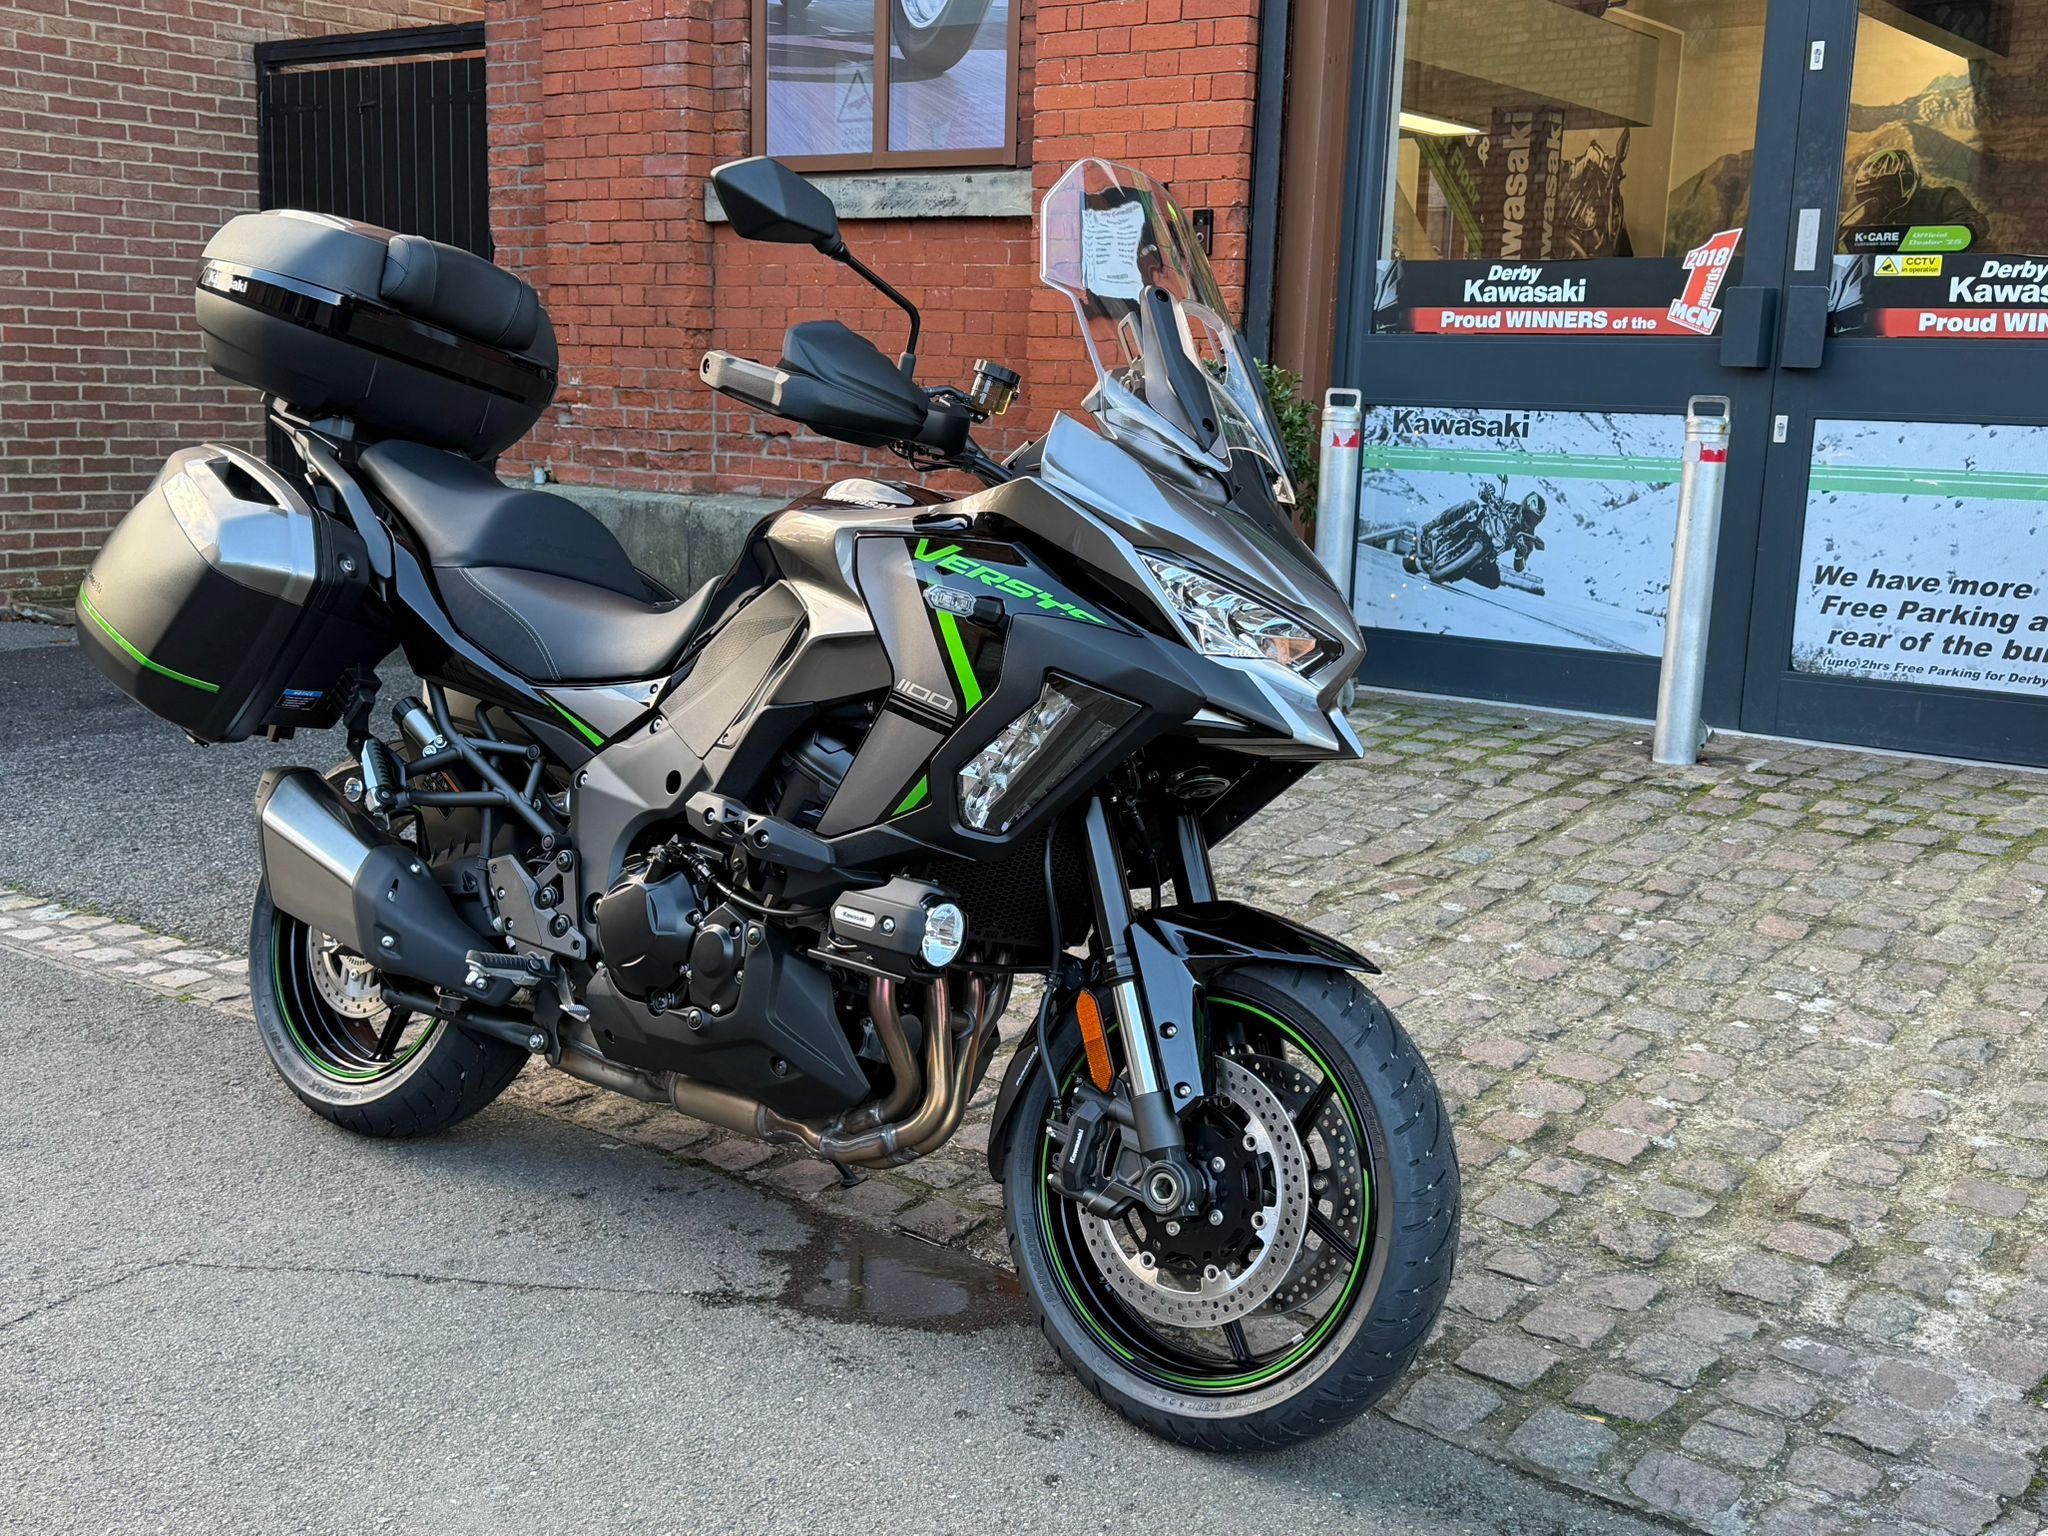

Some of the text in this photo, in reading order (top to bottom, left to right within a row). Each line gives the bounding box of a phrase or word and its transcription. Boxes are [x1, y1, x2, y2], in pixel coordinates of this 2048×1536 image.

[1501, 112, 1533, 259] wasaki
[1688, 247, 1731, 268] 2018
[1906, 257, 1936, 266] CCTV
[1980, 260, 2048, 283] Derby
[1488, 265, 1543, 284] Derby
[1697, 266, 1723, 308] awards
[1464, 279, 1587, 303] Kawasaki
[1441, 311, 1501, 329] Proud
[1506, 311, 1608, 329] WINNERS
[1612, 316, 1629, 329] of
[1631, 317, 1657, 329] the
[1671, 302, 1717, 329] MCN
[1918, 313, 1997, 333] Proud
[1392, 409, 1530, 438] Kawasaki
[1814, 565, 2033, 599] We have more
[1820, 595, 1888, 618] Free
[1897, 600, 2020, 634] Parking
[1827, 628, 1893, 649] rear
[1900, 632, 1935, 652] of
[1943, 636, 1993, 657] the
[1861, 659, 1890, 671] 2hrs
[1894, 662, 1924, 674] Free
[1928, 666, 1981, 681] Parking
[1985, 670, 2006, 681] for
[2008, 672, 2048, 687] Derby
[896, 678, 953, 710] 1100
[1069, 1128, 1084, 1164] Kawasaki
